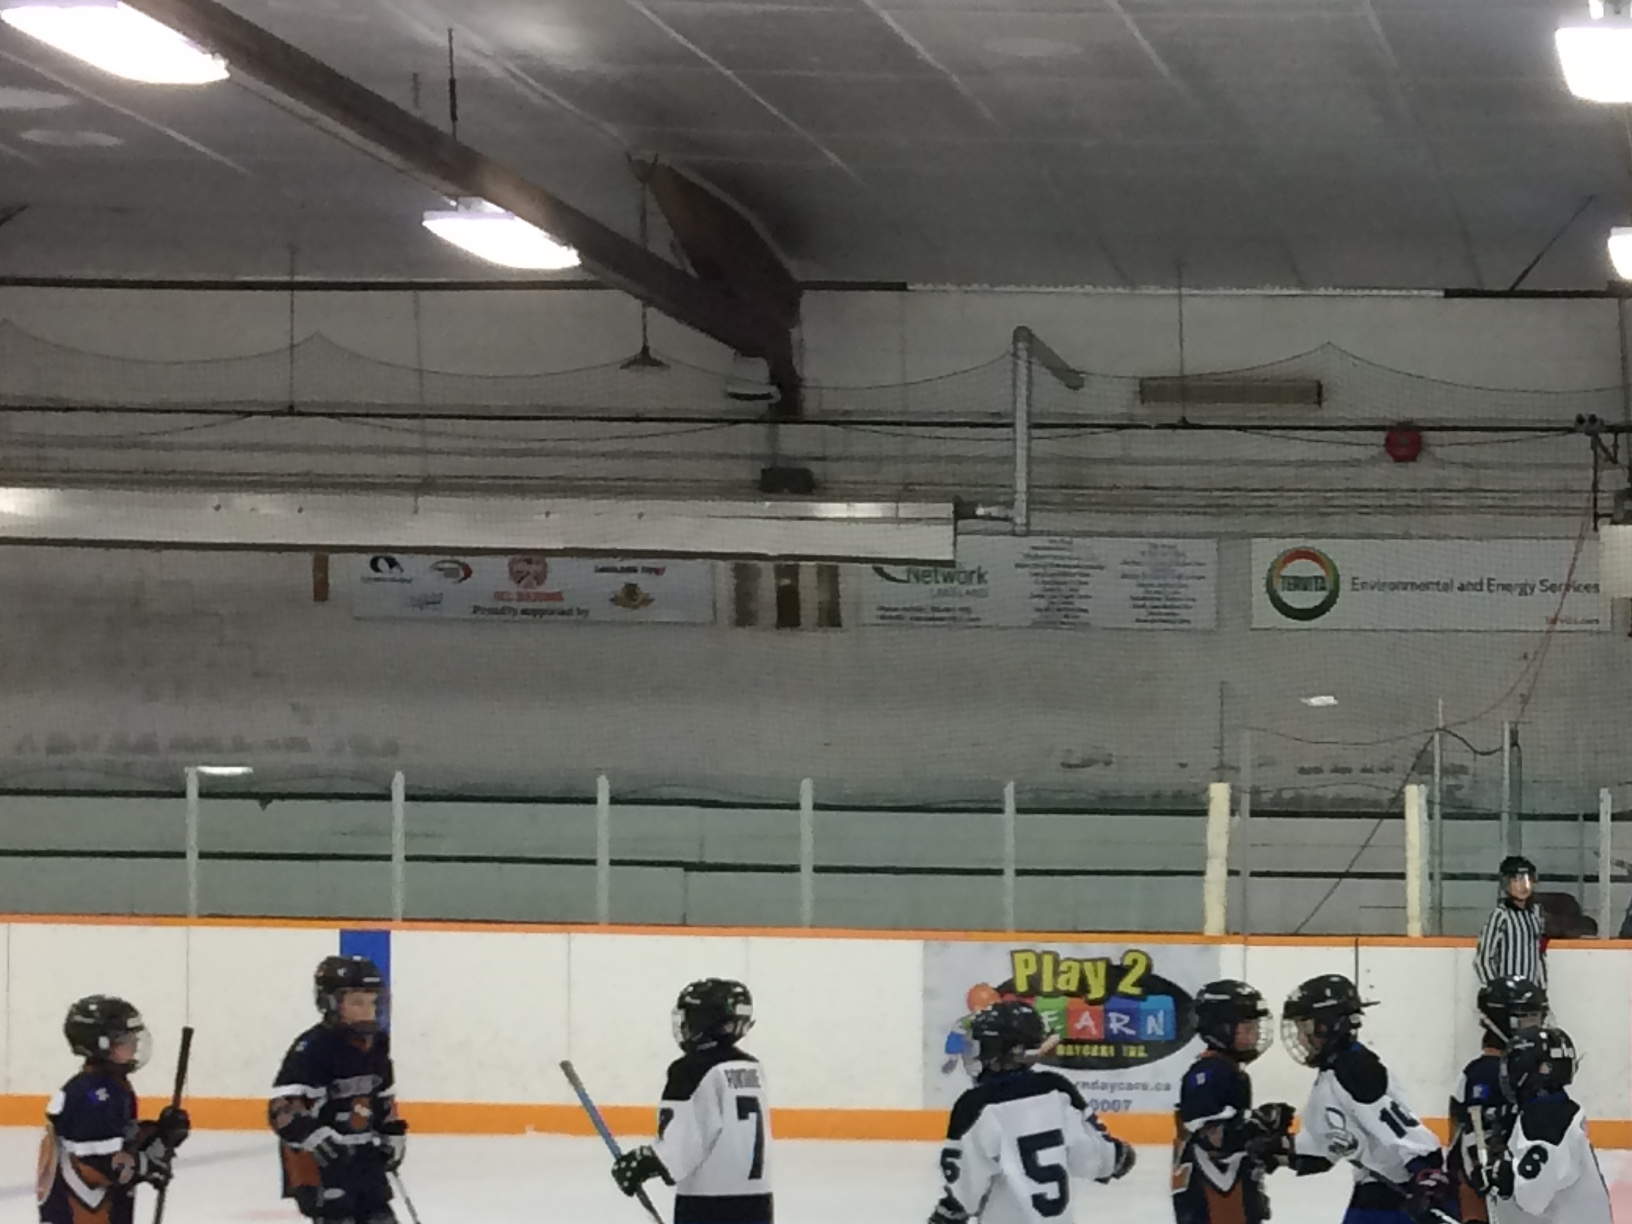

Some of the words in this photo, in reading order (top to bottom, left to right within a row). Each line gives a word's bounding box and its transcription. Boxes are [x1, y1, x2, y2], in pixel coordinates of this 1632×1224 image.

[907, 566, 989, 585] Network
[1351, 577, 1454, 593] Environmental
[1457, 577, 1483, 592] and
[1486, 578, 1536, 597] Energy
[1539, 577, 1600, 595] Services
[575, 606, 590, 618] by
[1011, 950, 1107, 1000] Play
[1120, 950, 1151, 996] 2
[1042, 1009, 1166, 1038] EARN
[736, 1095, 765, 1181] 7
[1017, 1129, 1070, 1218] 5
[1517, 1145, 1549, 1179] 6
